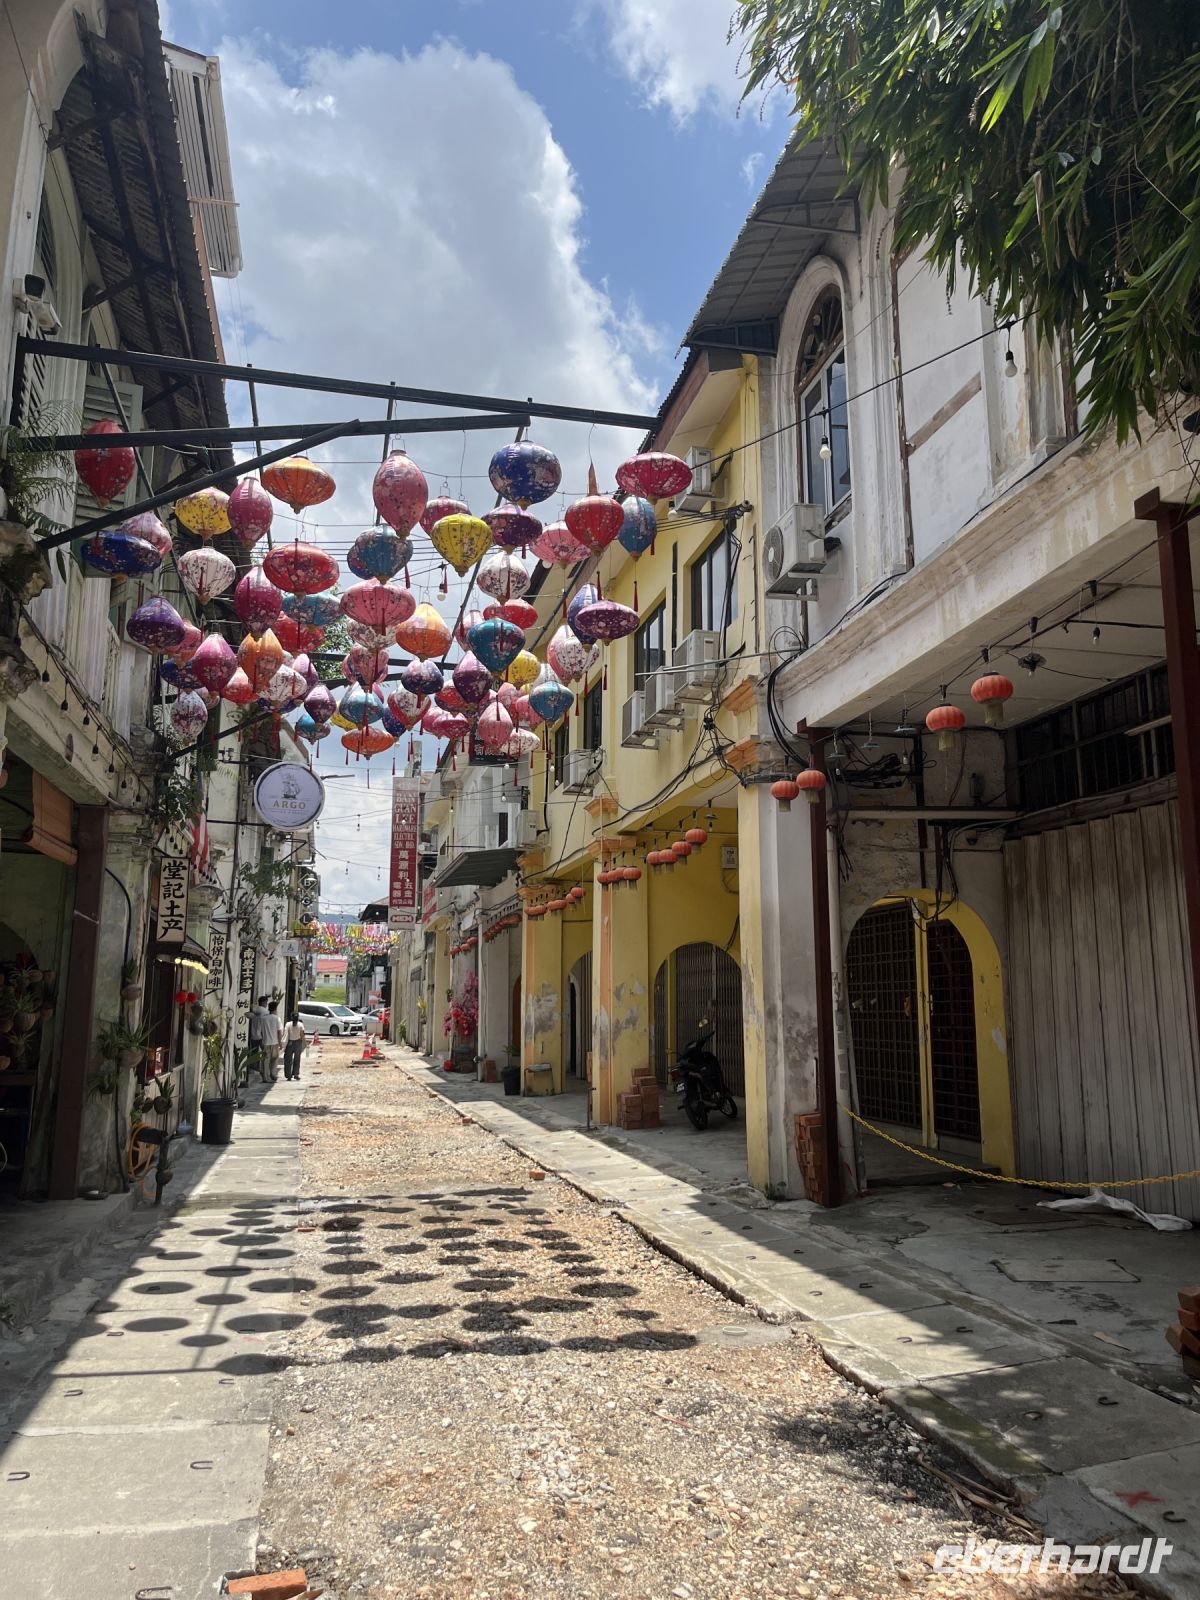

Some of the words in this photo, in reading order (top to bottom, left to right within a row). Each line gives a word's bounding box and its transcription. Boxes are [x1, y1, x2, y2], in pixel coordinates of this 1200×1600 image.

[396, 793, 416, 803] BAN
[273, 800, 306, 809] ARGO
[394, 804, 417, 813] GUAN
[159, 860, 187, 939] 堂記土产
[209, 935, 224, 988] 怡保白咖啡
